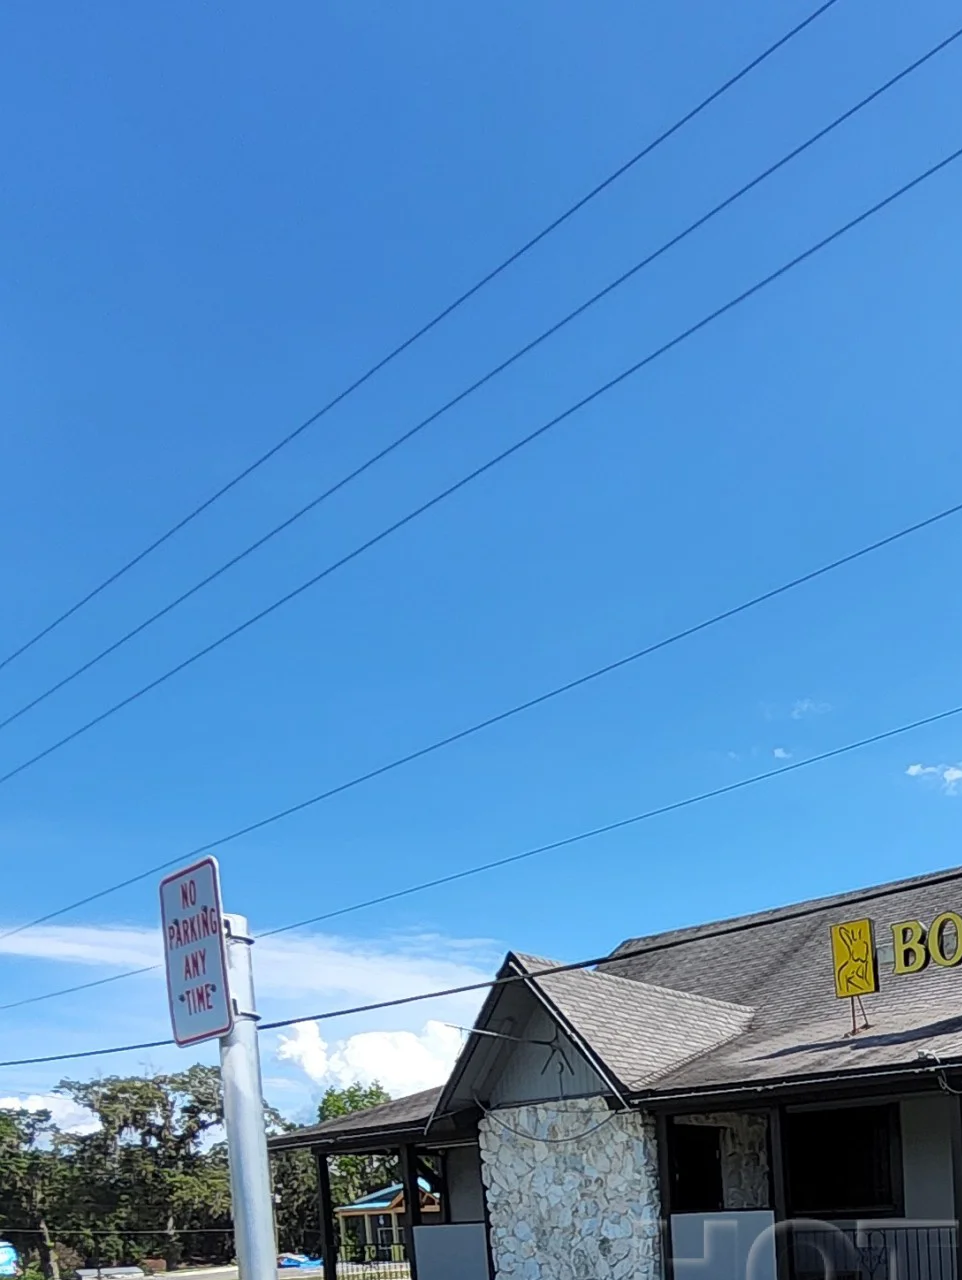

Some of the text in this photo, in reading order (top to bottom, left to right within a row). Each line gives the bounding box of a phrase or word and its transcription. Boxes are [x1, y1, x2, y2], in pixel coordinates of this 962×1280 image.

[180, 880, 197, 909] NO
[168, 908, 217, 949] PARKING
[184, 948, 207, 980] ANY
[185, 984, 213, 1016] TIME
